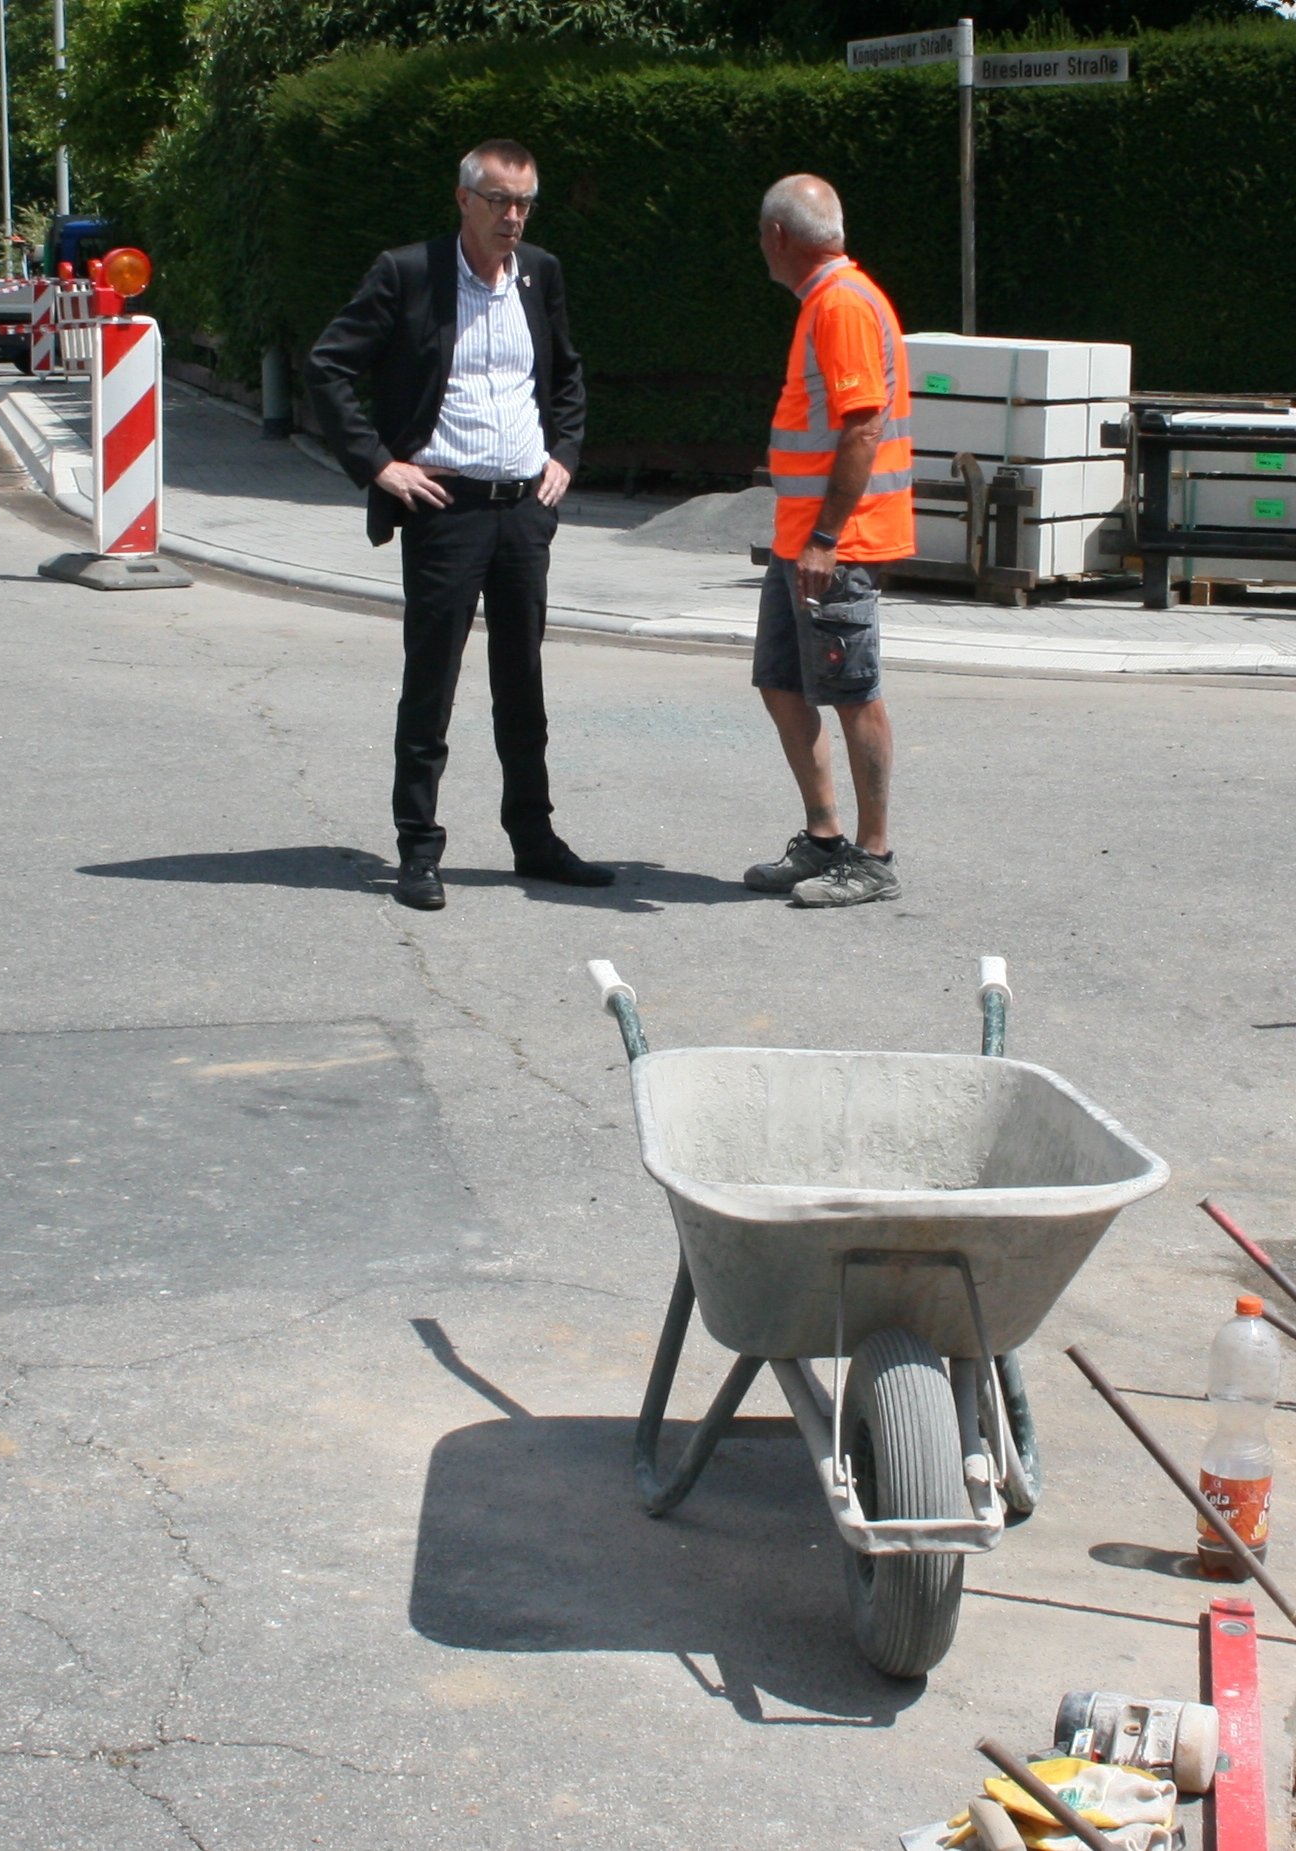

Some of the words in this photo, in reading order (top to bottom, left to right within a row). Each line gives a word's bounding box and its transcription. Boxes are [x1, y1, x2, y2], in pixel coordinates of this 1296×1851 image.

[852, 42, 917, 67] Königsberger
[920, 35, 953, 55] Straße
[982, 60, 1059, 79] Breslauer
[1067, 55, 1118, 75] Straße
